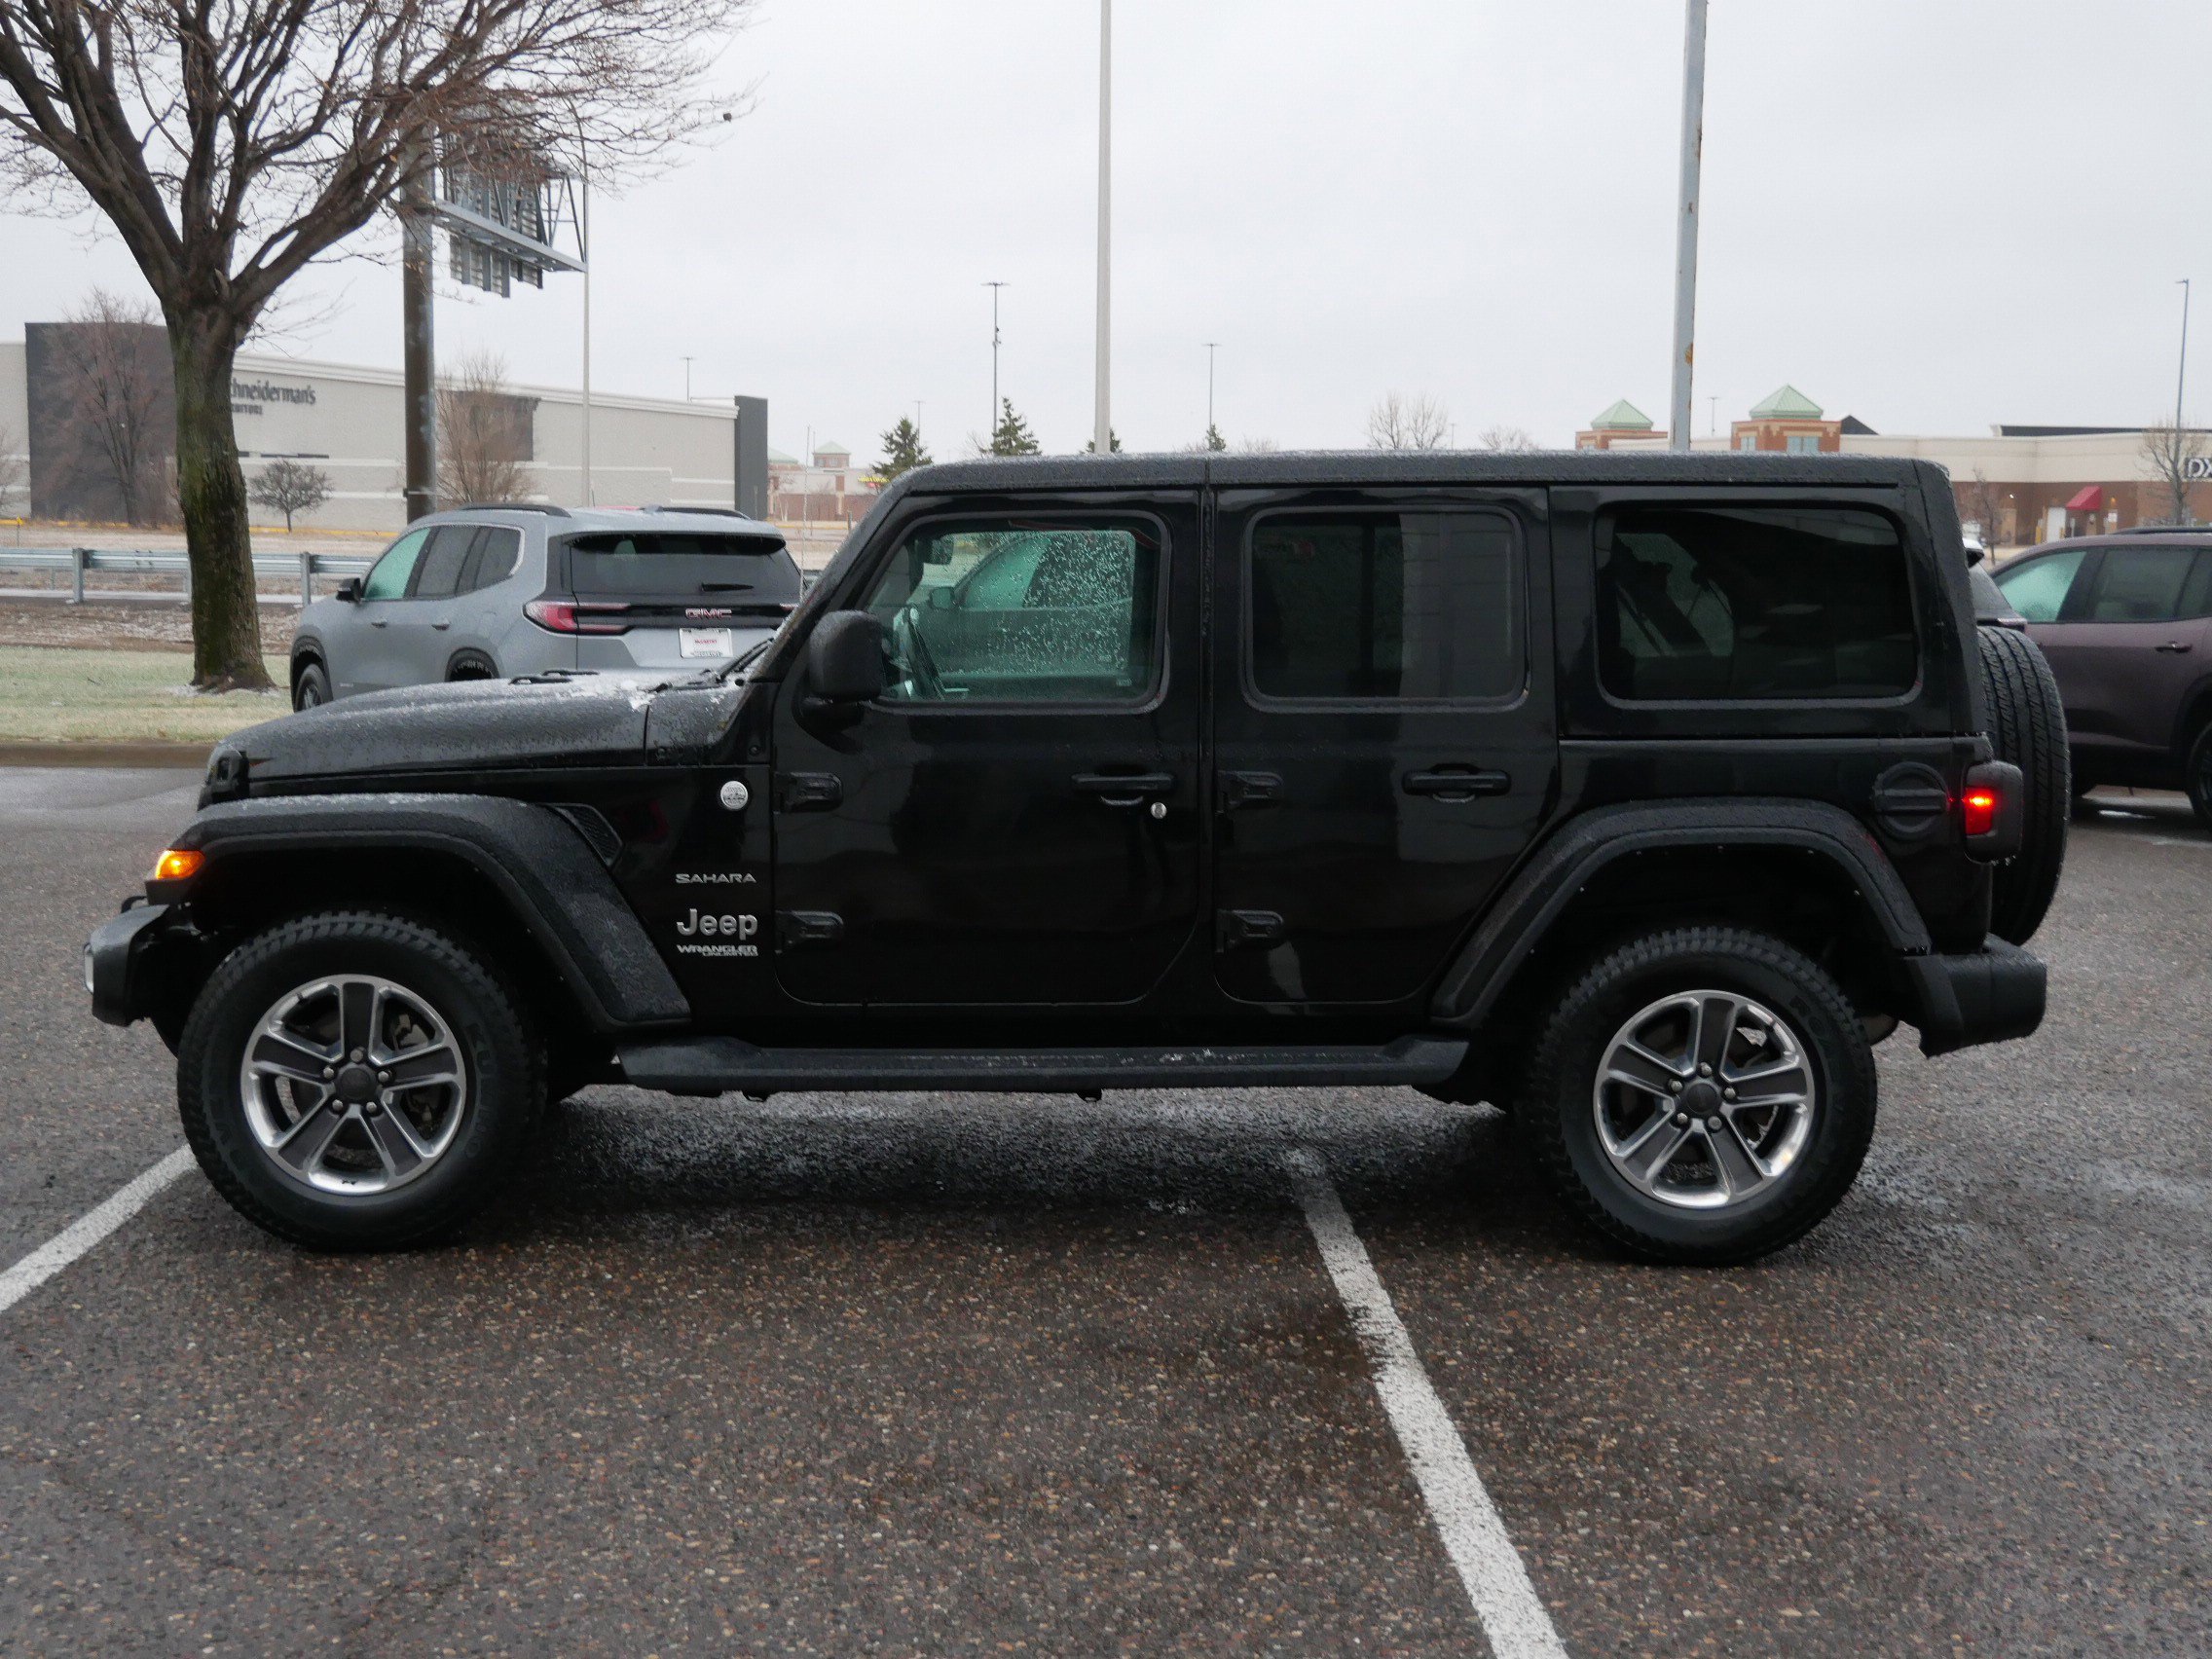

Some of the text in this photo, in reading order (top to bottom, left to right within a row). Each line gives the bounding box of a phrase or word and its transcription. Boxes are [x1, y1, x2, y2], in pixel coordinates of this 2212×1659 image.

[231, 378, 316, 405] hneiderman's
[685, 608, 732, 619] GMC
[676, 872, 756, 884] SAHARA
[676, 907, 758, 941] Jeep
[676, 943, 758, 954] WRANGLER
